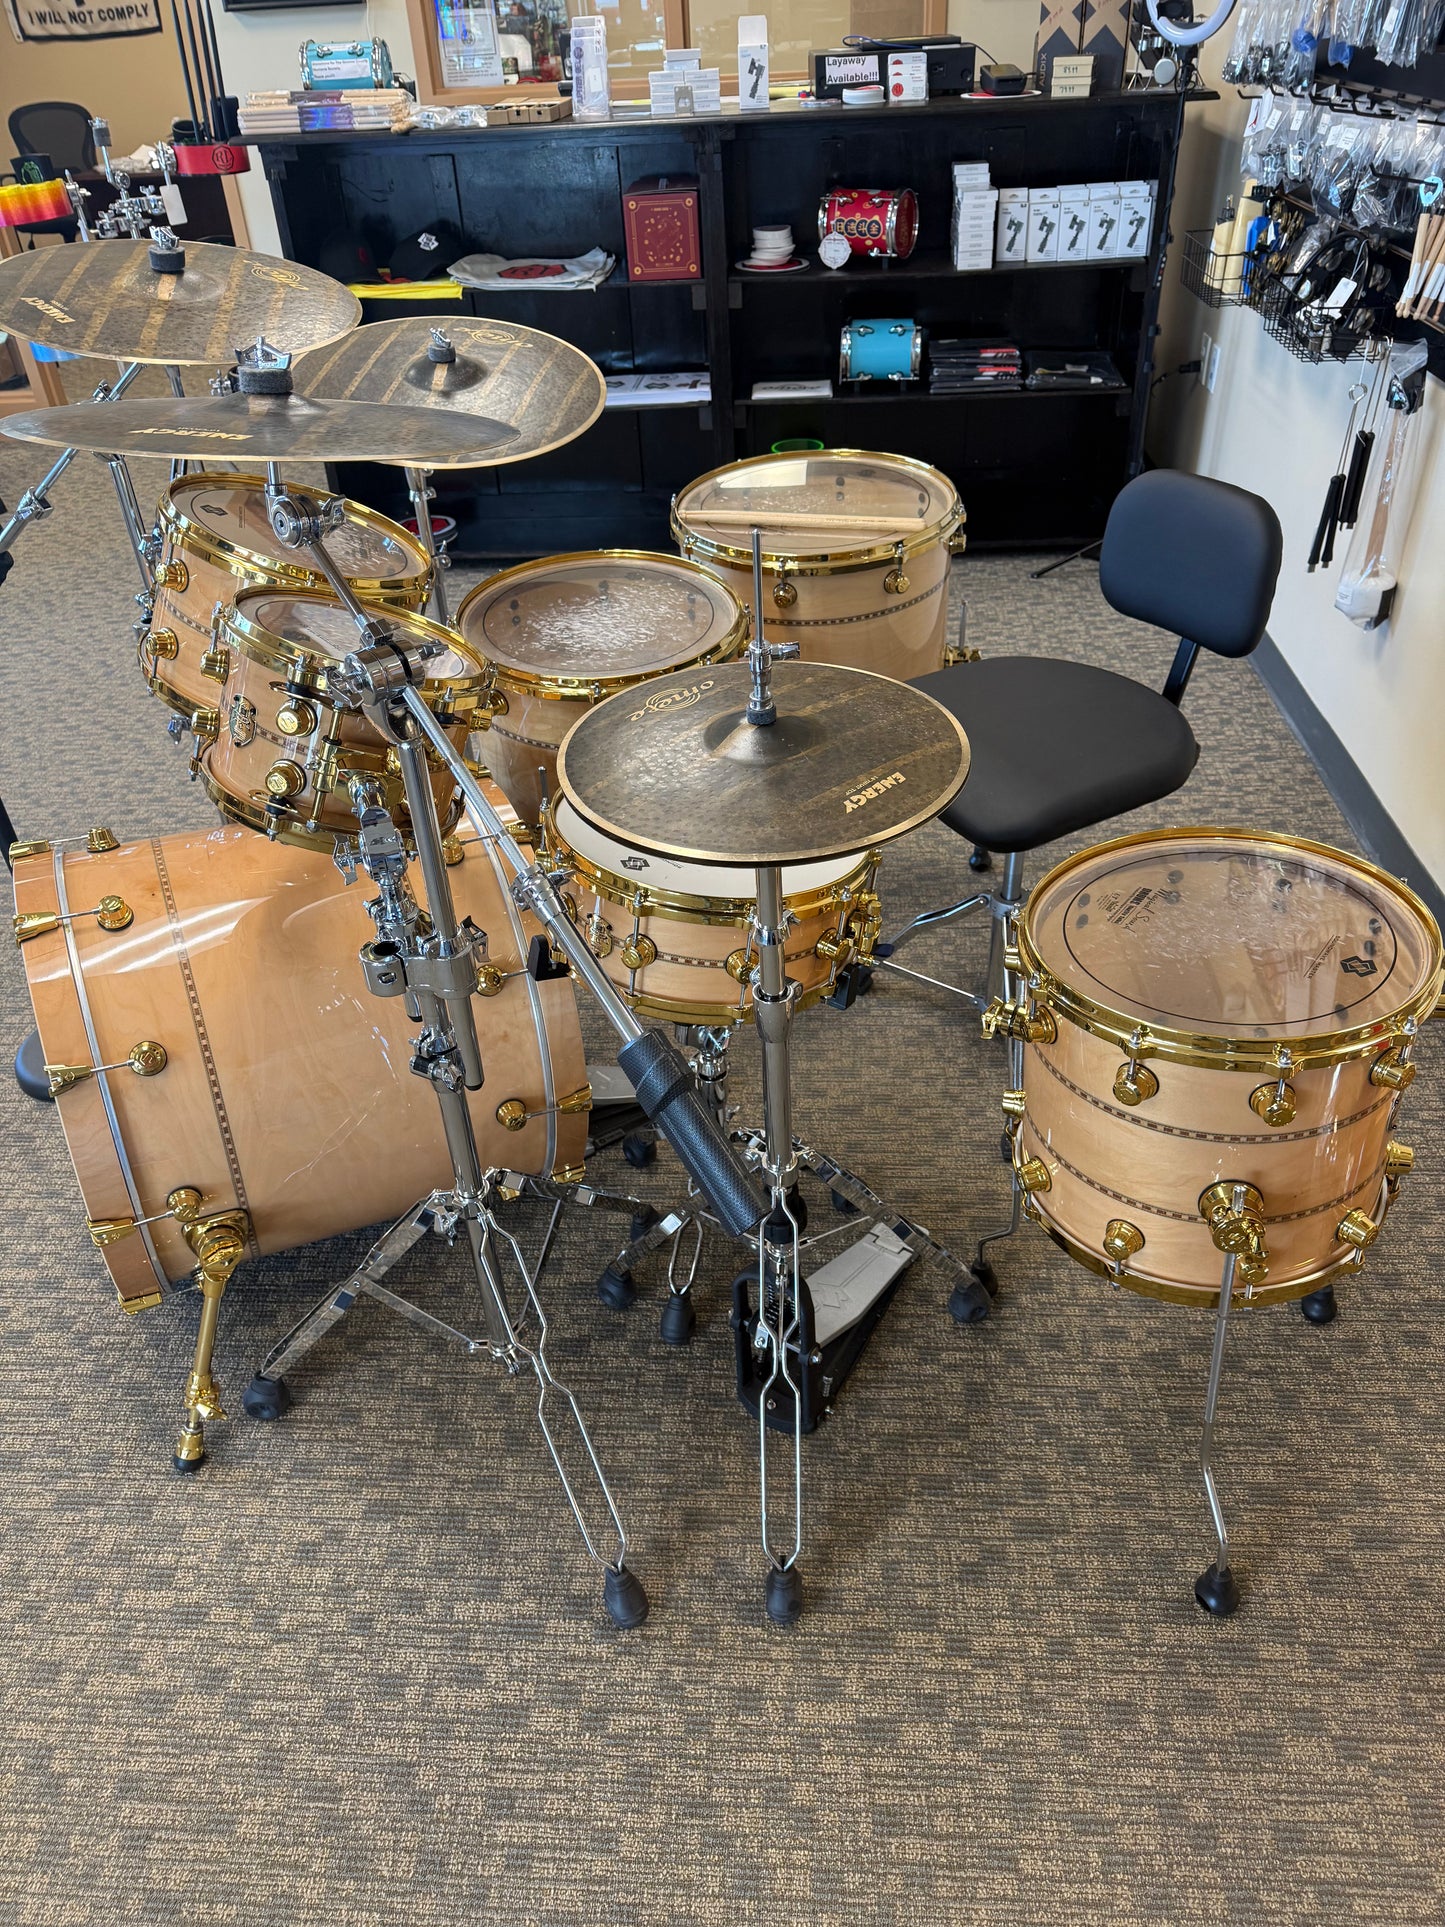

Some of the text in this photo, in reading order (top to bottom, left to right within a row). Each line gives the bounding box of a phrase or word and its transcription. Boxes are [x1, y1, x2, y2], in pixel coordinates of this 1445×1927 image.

[27, 3, 149, 25] I WILL NOT COMPLY
[827, 56, 867, 68] Layaway
[1039, 53, 1047, 86] AUDIX
[827, 72, 878, 83] Available!!!
[20, 297, 76, 324] ENERGY
[128, 428, 254, 441] ENERGY
[843, 771, 906, 814] ENERGY
